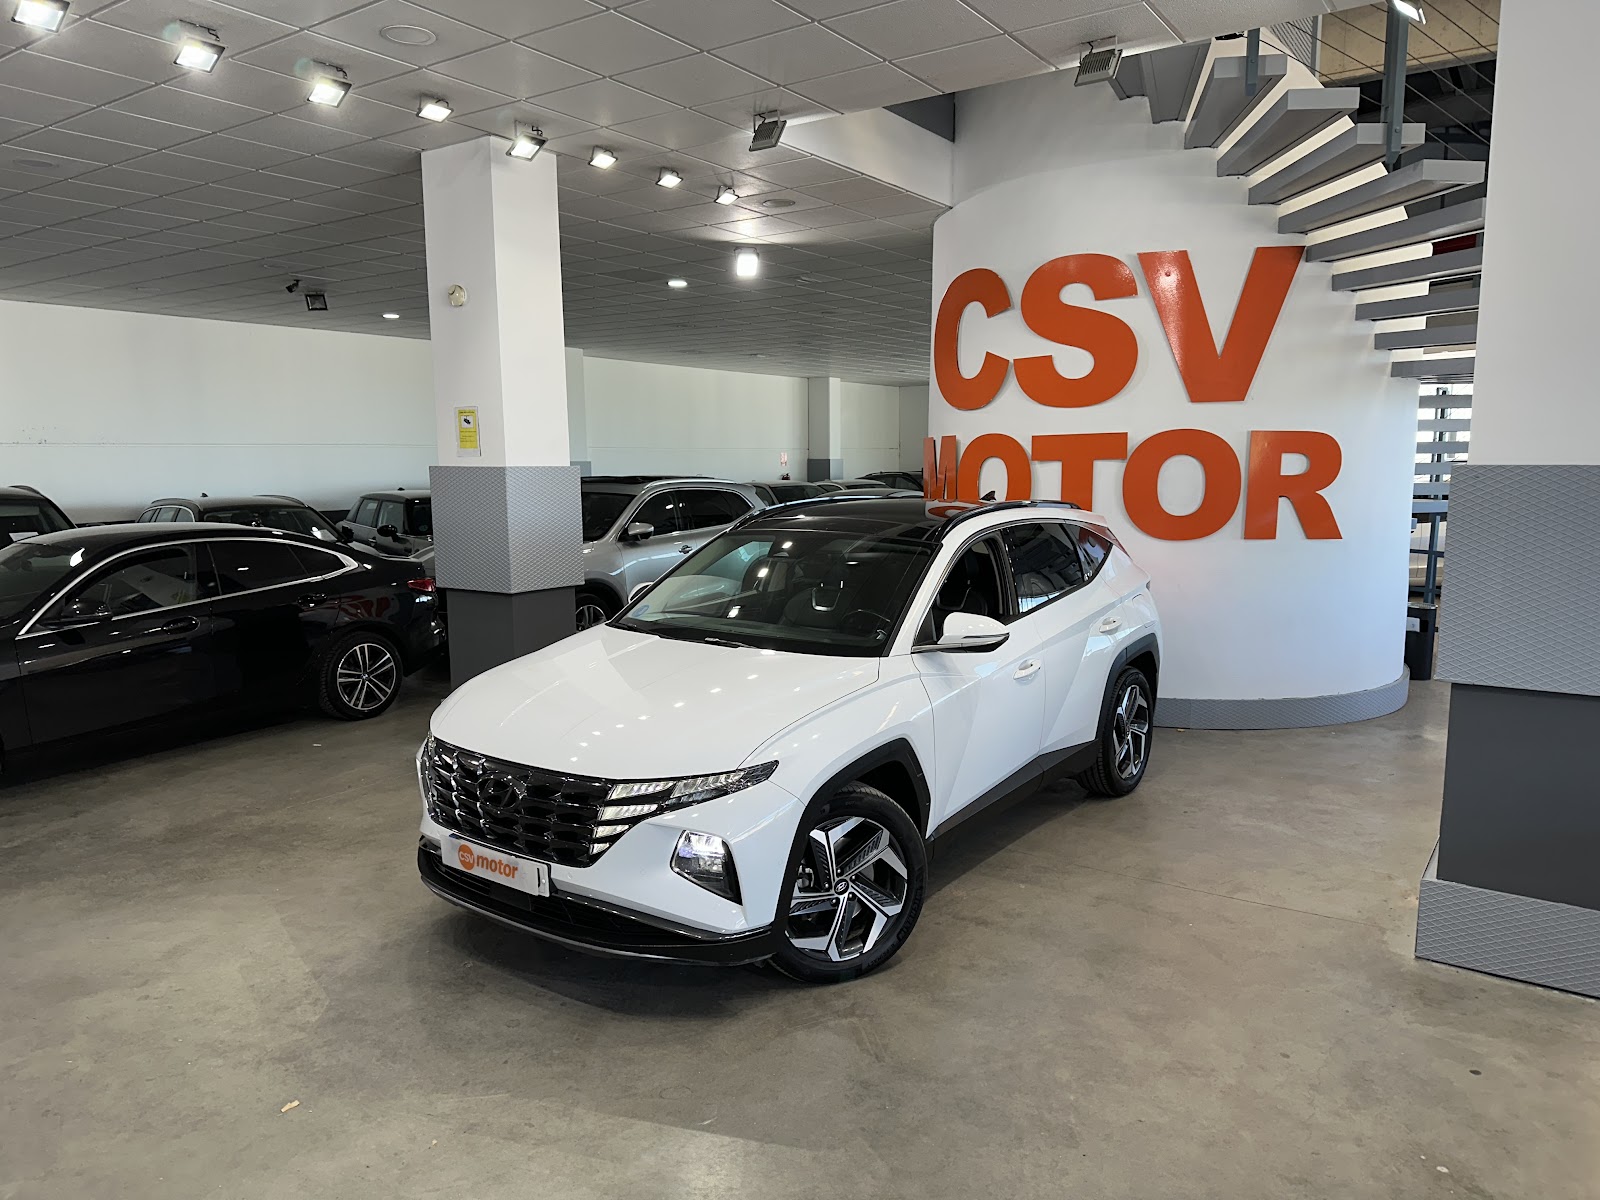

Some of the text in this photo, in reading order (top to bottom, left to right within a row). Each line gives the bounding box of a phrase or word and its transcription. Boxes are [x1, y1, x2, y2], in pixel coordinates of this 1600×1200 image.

[933, 245, 1306, 411] CSV
[923, 428, 1343, 540] MOTOR
[458, 851, 518, 879] CSV motor
